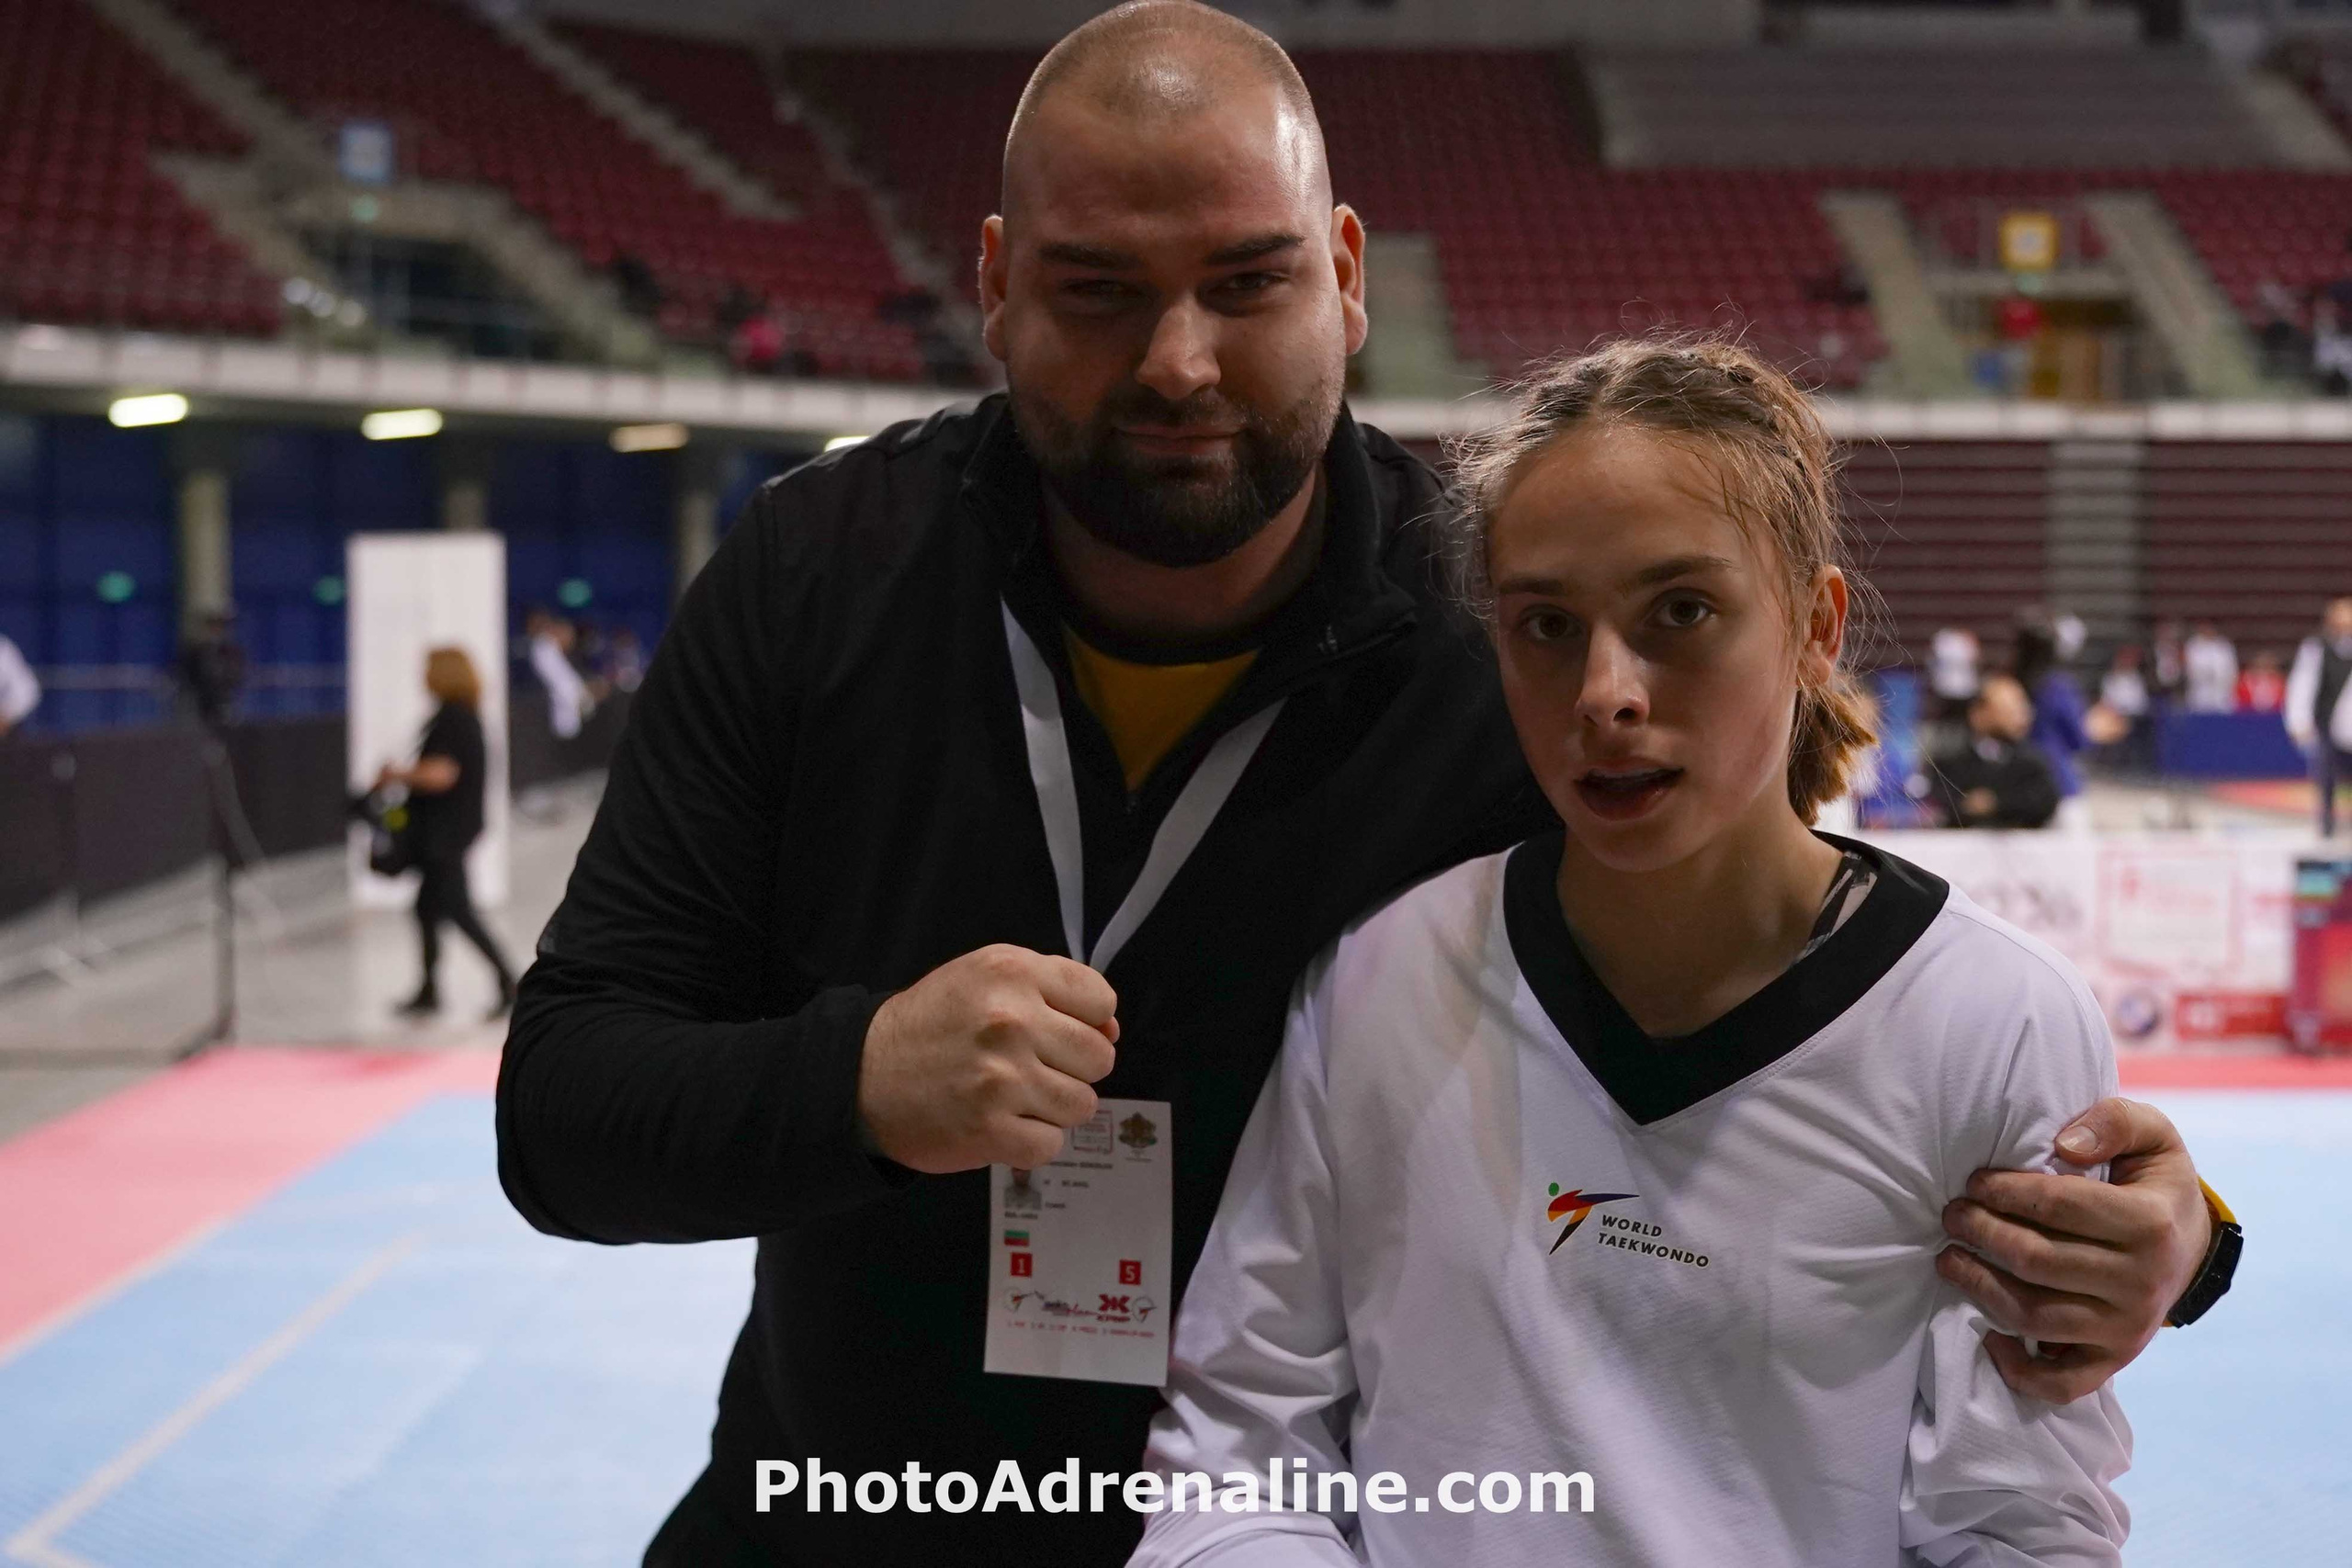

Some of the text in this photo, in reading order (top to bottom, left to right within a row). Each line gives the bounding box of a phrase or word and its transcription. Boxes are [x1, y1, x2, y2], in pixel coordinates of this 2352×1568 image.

[1602, 1214, 1662, 1237] WORLD
[1598, 1233, 1709, 1267] TAEKWONDO
[1125, 1265, 1136, 1282] 5
